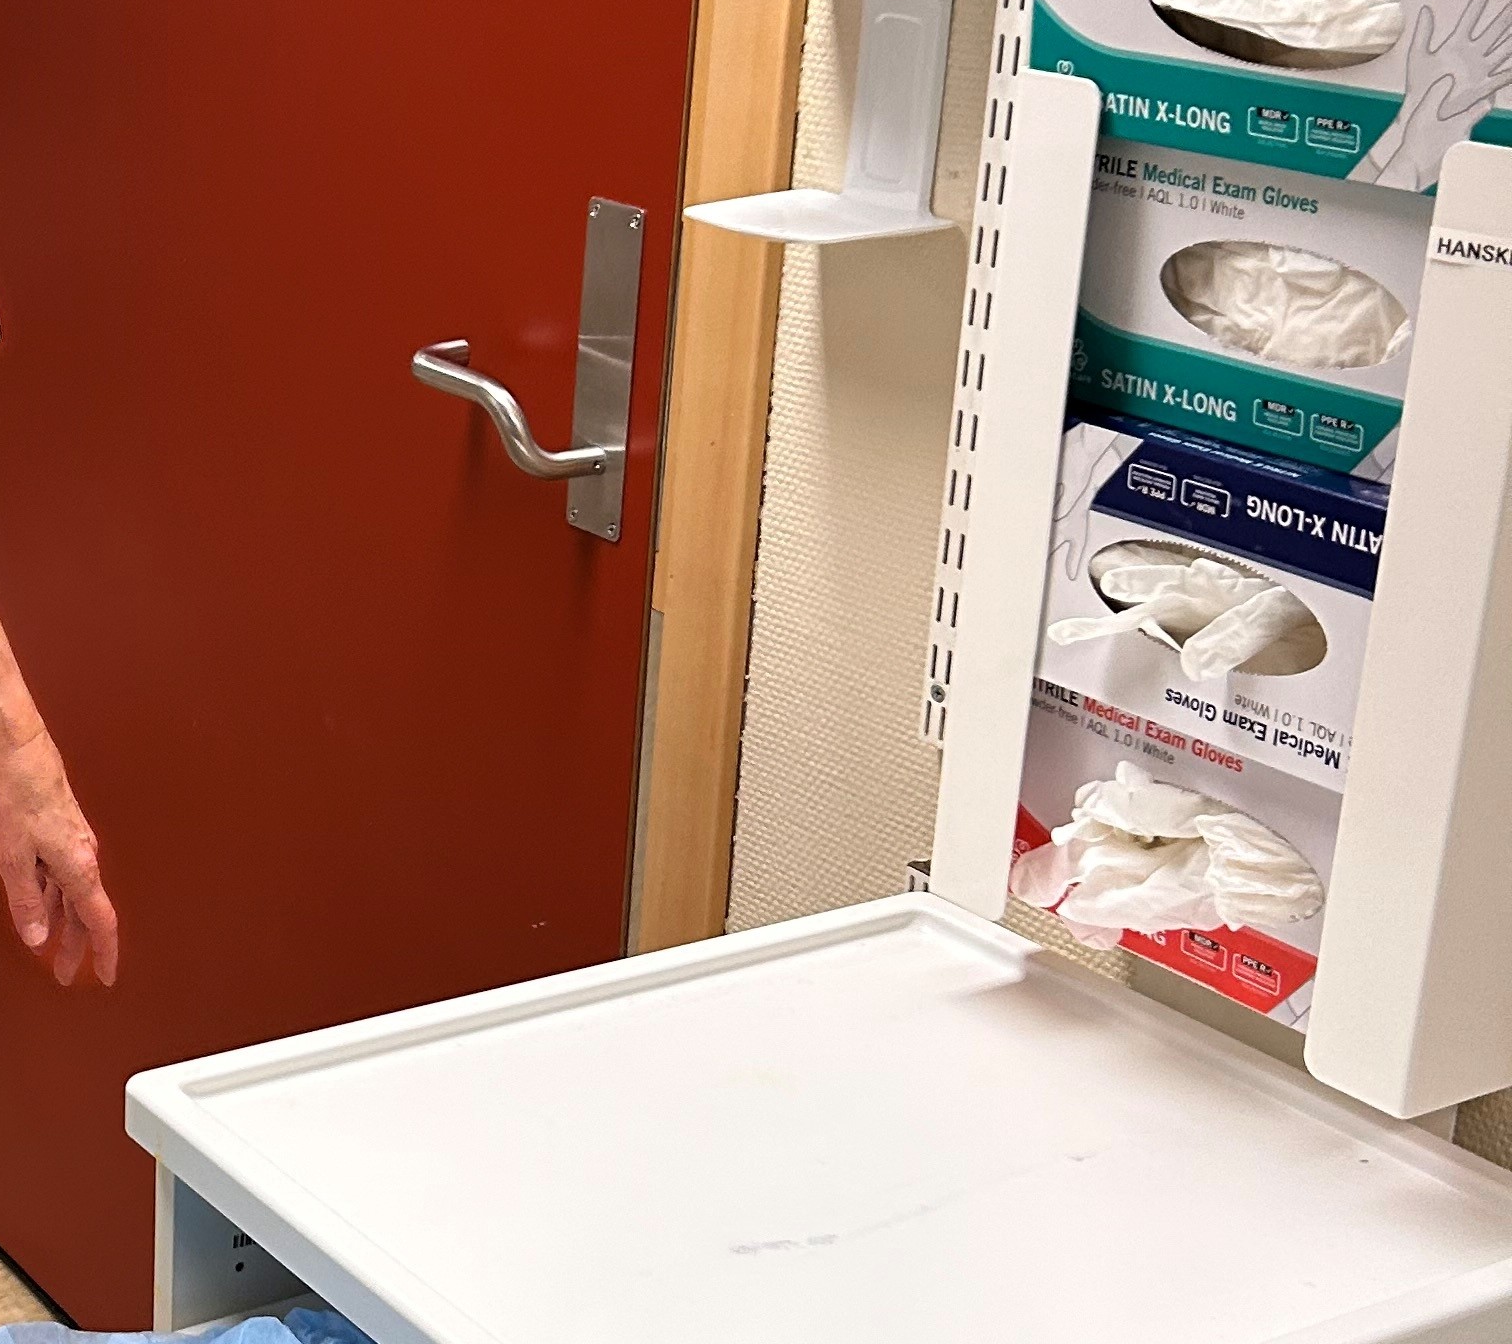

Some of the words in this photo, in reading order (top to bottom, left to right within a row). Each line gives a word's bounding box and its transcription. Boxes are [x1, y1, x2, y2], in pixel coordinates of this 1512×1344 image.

[1104, 92, 1150, 119] ATIN
[1155, 100, 1232, 134] X-LONG
[1095, 154, 1138, 178] RILE
[1143, 163, 1206, 191] Medical
[1212, 176, 1257, 202] Exam
[1262, 185, 1319, 214] Gloves
[1147, 188, 1173, 205] AQL
[1179, 193, 1198, 210] 1.0
[1210, 199, 1246, 220] White
[1436, 237, 1512, 266] HANSK
[1101, 368, 1158, 401] SATIN
[1162, 384, 1237, 422] X-LONG
[1246, 494, 1326, 538] X-LONG
[1331, 520, 1384, 554] ATIN
[1165, 688, 1217, 722] Gloves
[1234, 694, 1270, 719] White
[1281, 712, 1304, 732] 1.0
[1033, 676, 1079, 707] ITRILE
[1082, 696, 1141, 731] Medical
[1144, 720, 1186, 750] Exam
[1191, 739, 1243, 773] Gloves
[1223, 709, 1267, 742] Exam
[1309, 721, 1336, 742] AQL
[1142, 740, 1175, 765] White
[1273, 728, 1341, 769] Medical
